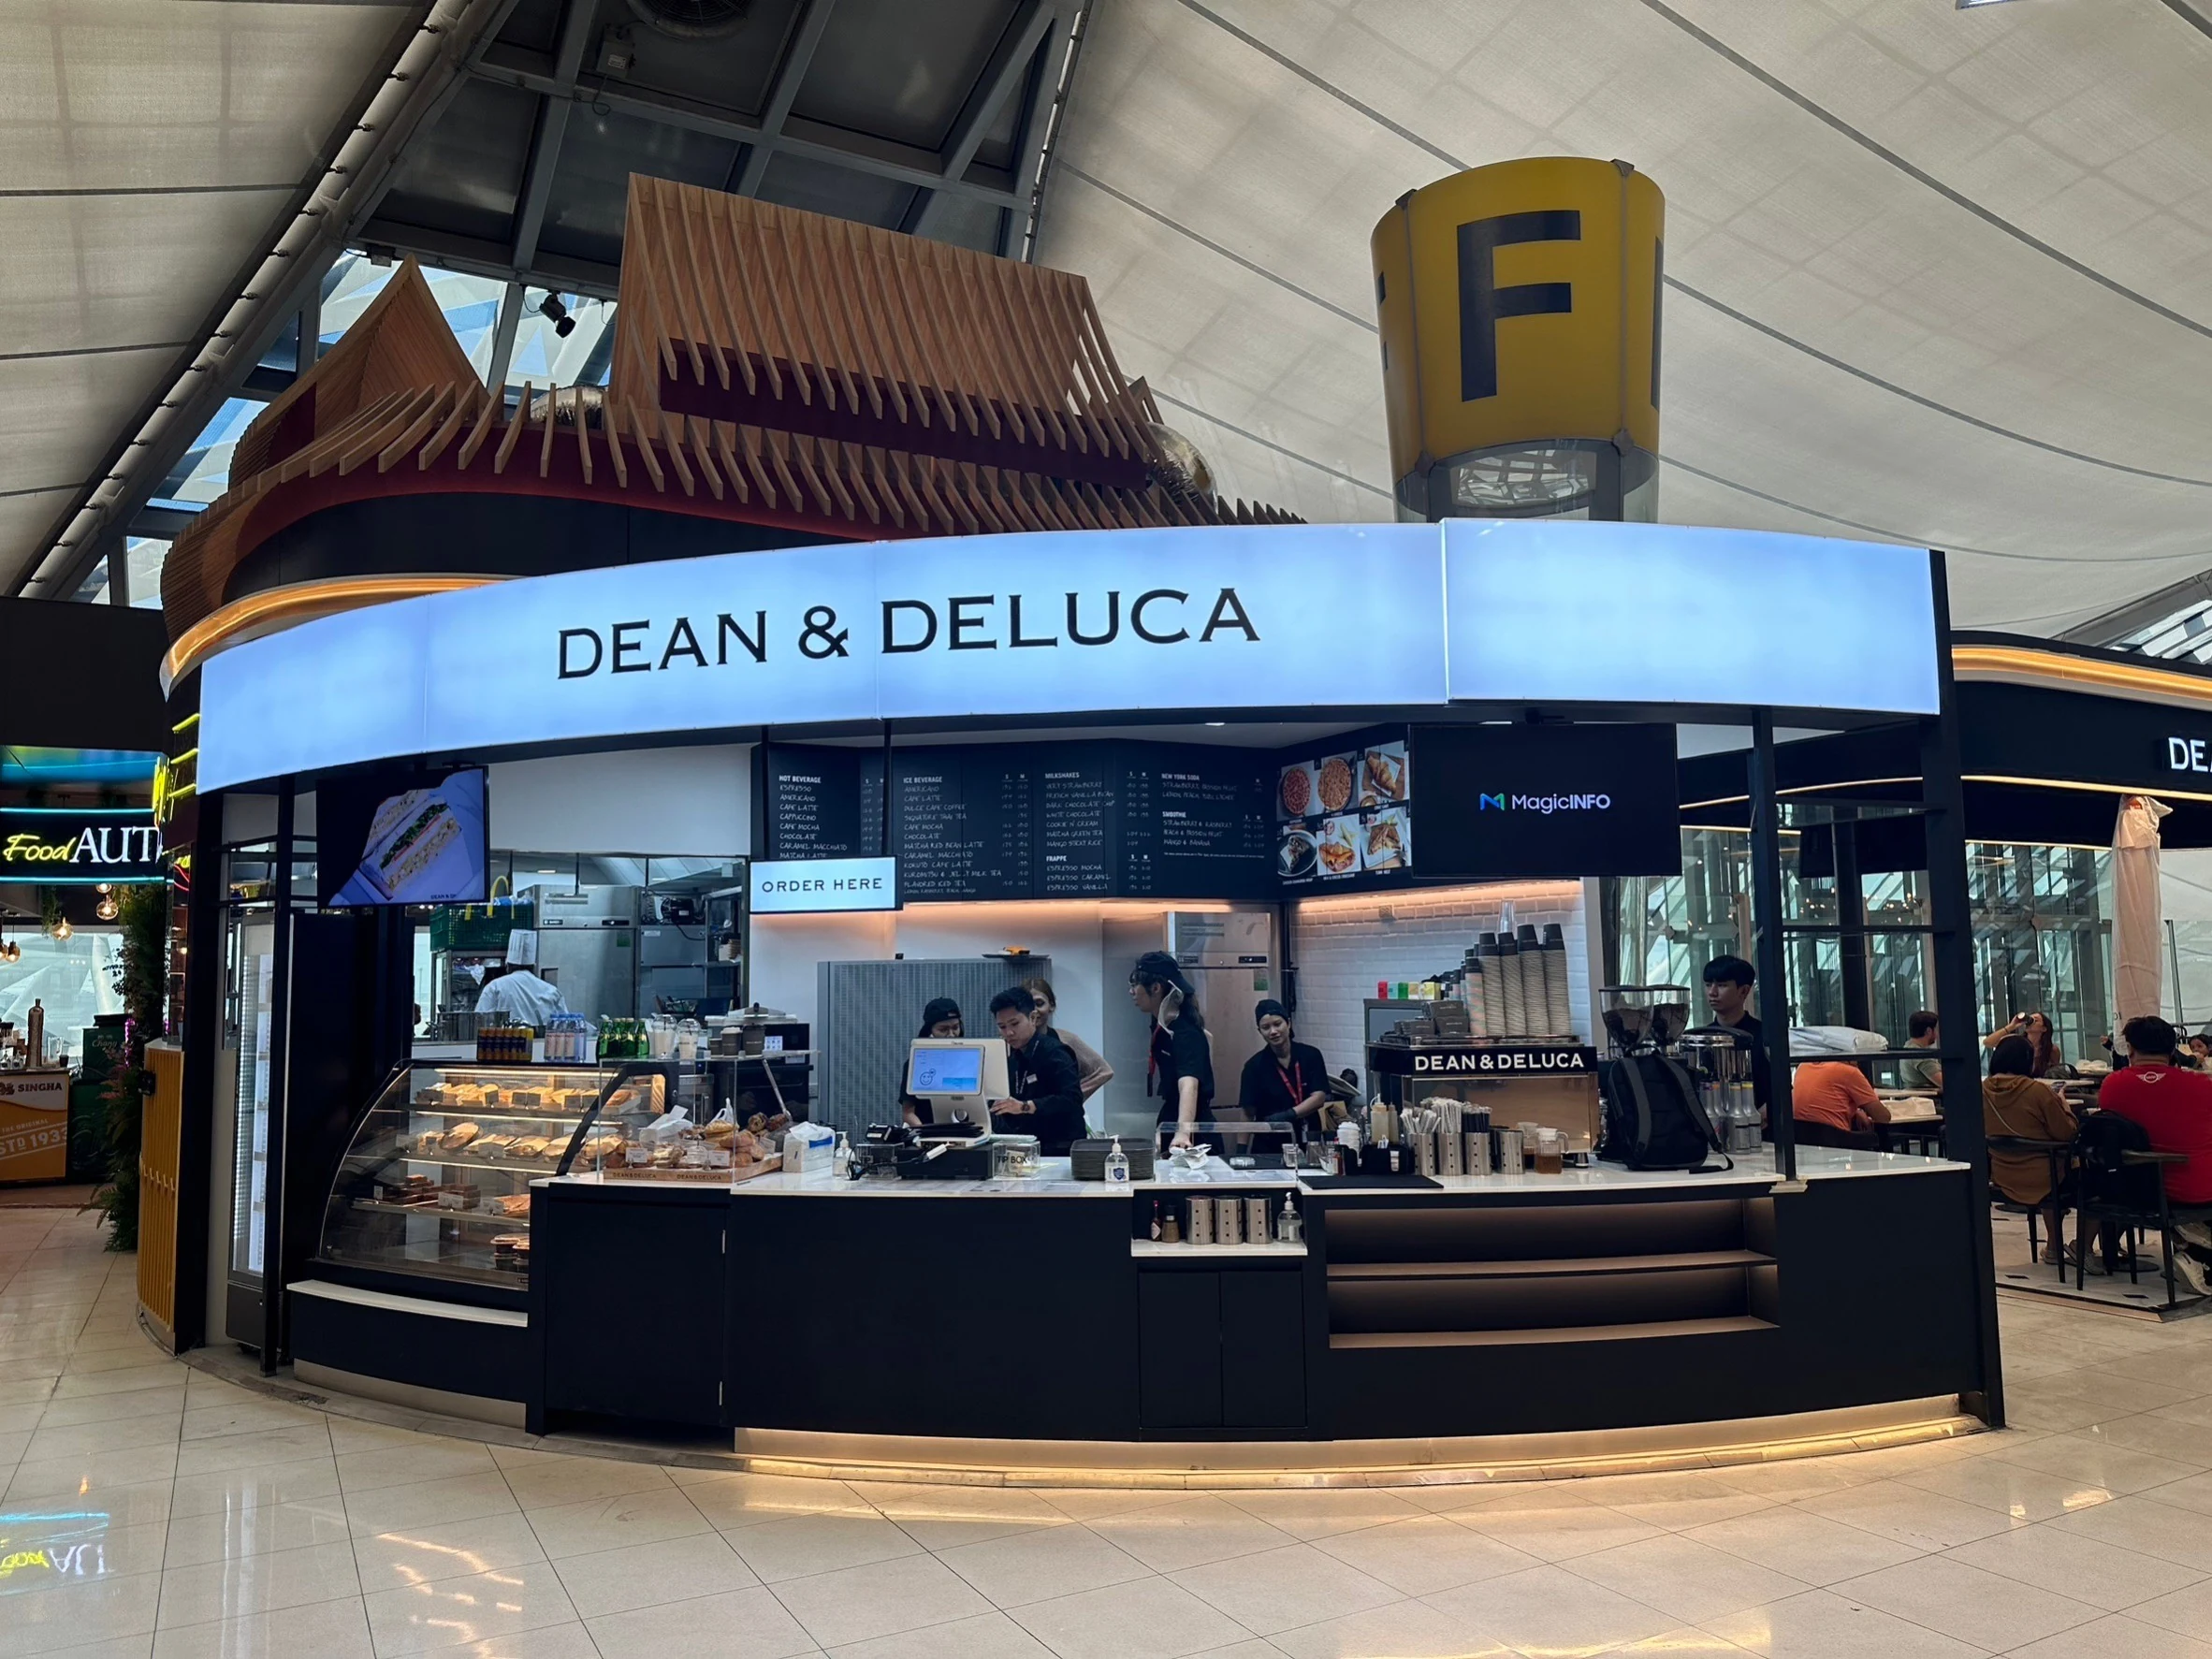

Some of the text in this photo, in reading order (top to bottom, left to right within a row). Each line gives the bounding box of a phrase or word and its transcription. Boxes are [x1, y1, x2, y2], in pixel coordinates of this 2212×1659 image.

[1457, 211, 1581, 402] F
[558, 588, 1260, 679] DEAN & DELUCA
[2168, 736, 2212, 773] DE
[792, 776, 822, 784] BEVERAGE
[1512, 793, 1610, 814] MagicINFO
[3, 834, 77, 862] Food
[762, 878, 882, 893] ORDER HERE
[18, 1082, 63, 1093] SINGHA
[17, 1118, 49, 1131] ORIGINAL
